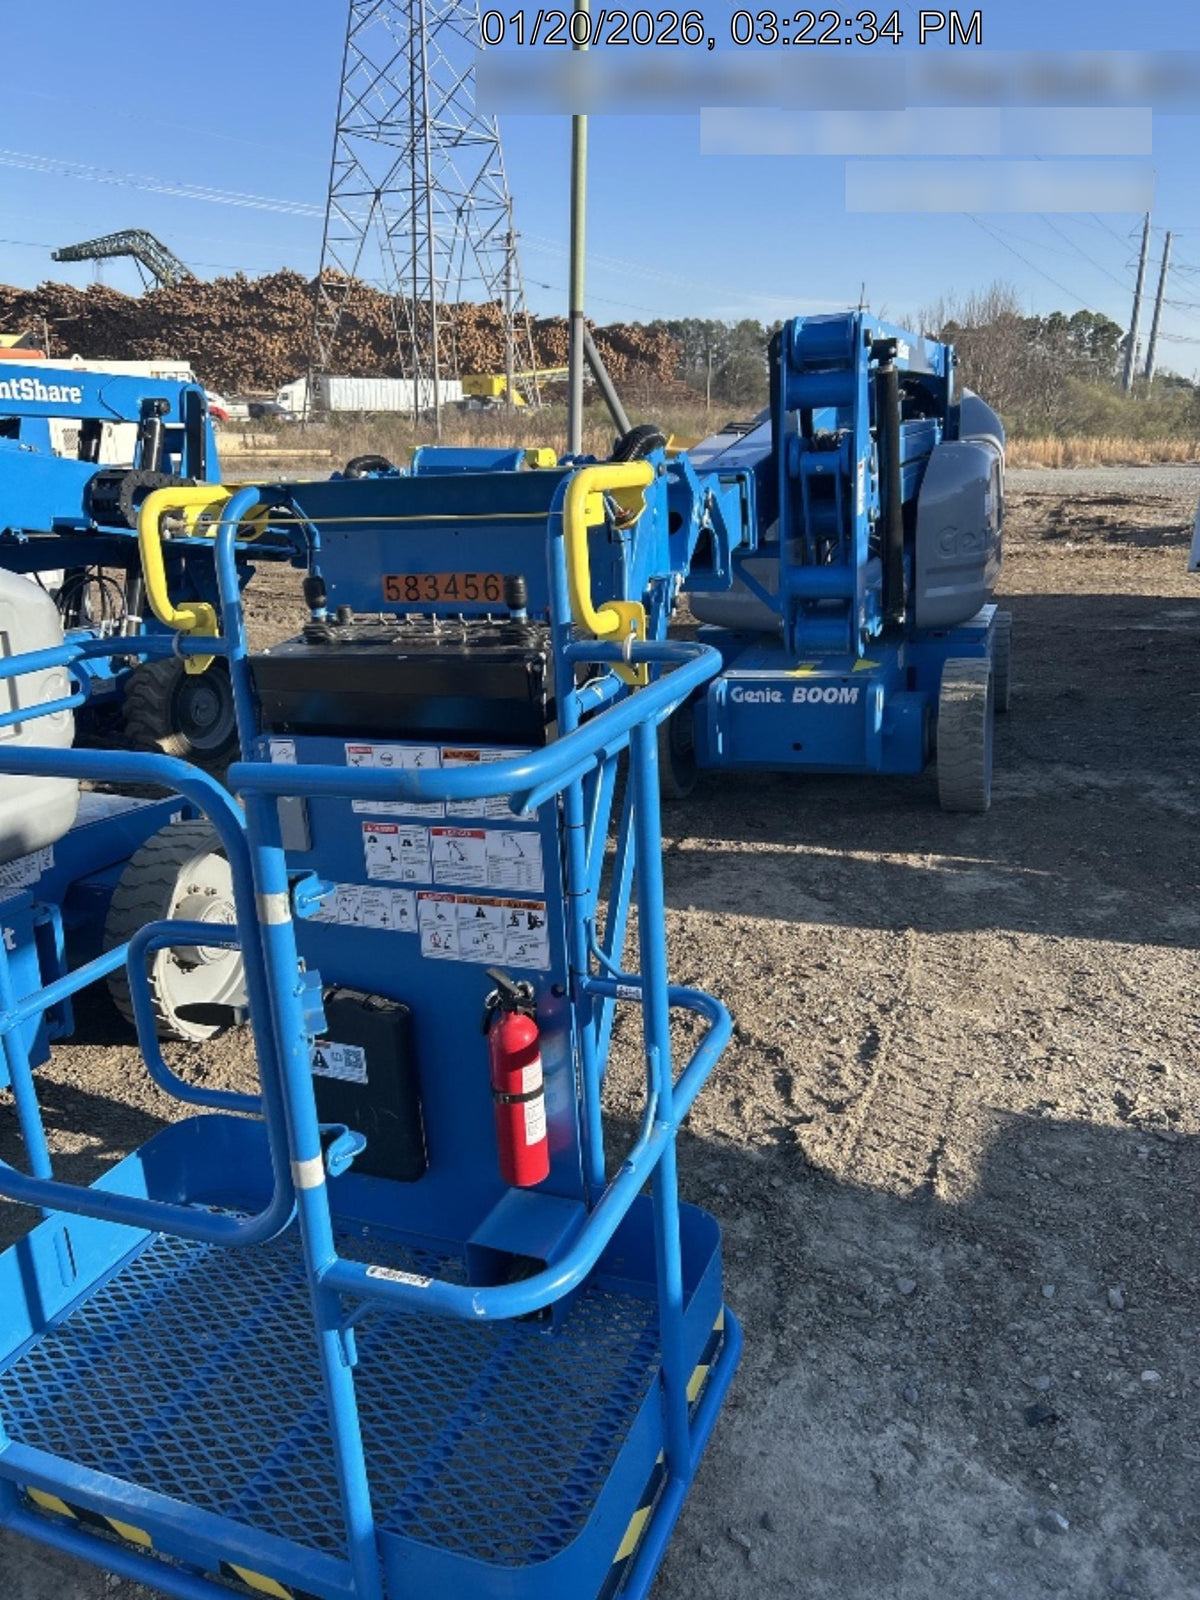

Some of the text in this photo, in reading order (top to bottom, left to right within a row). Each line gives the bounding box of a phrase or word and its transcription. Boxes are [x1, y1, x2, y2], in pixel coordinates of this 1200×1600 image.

[385, 574, 501, 602] 583456
[730, 686, 860, 705] Genie BOOM
